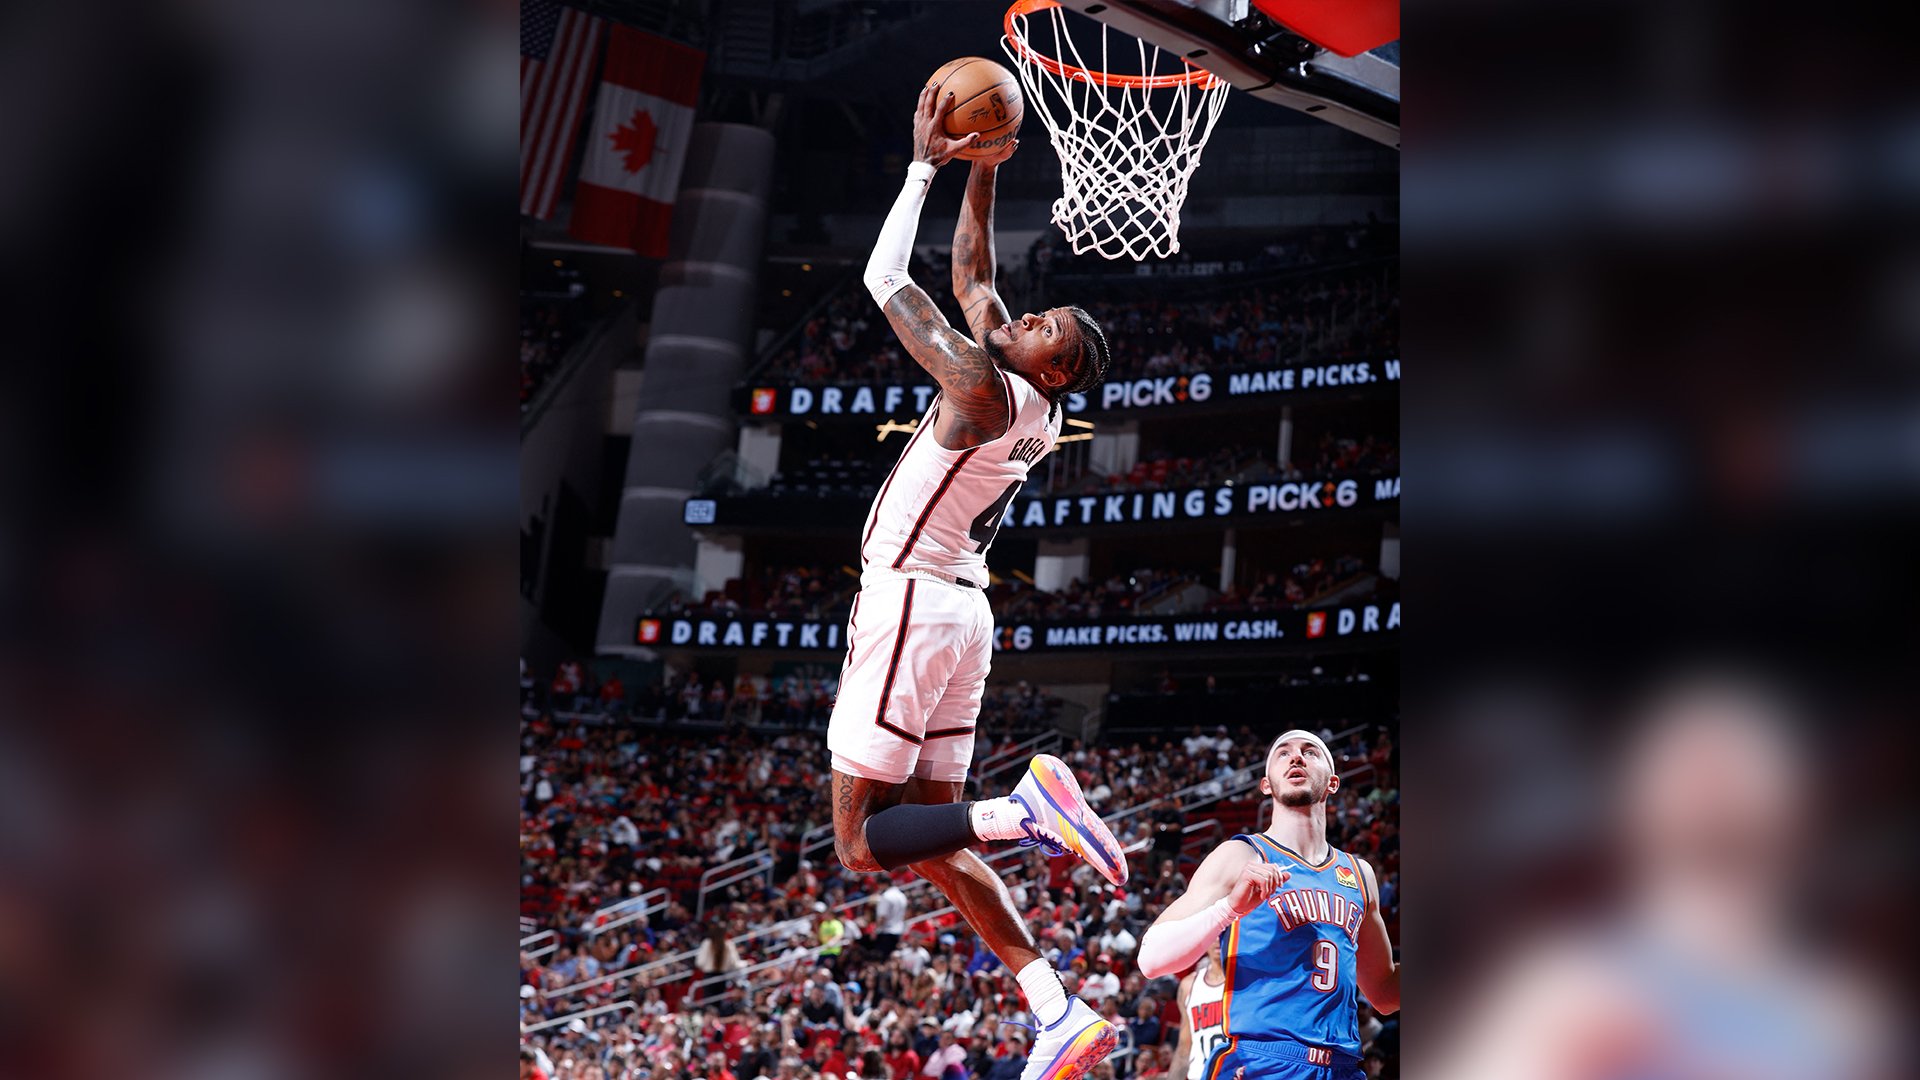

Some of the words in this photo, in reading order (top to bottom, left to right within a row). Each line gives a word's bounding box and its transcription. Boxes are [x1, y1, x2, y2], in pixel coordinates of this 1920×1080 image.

[1229, 369, 1295, 395] MAKE
[1302, 362, 1377, 388] PICKS.
[1001, 488, 1233, 527] RAFTKINGS
[672, 620, 839, 648] DRAFTKI
[1046, 626, 1101, 646] MAKE
[1106, 624, 1168, 643] PICKS.
[1174, 622, 1218, 641] WIN
[1224, 619, 1284, 639] CASH.
[1312, 940, 1338, 992] 9
[1308, 1046, 1332, 1065] OKC
